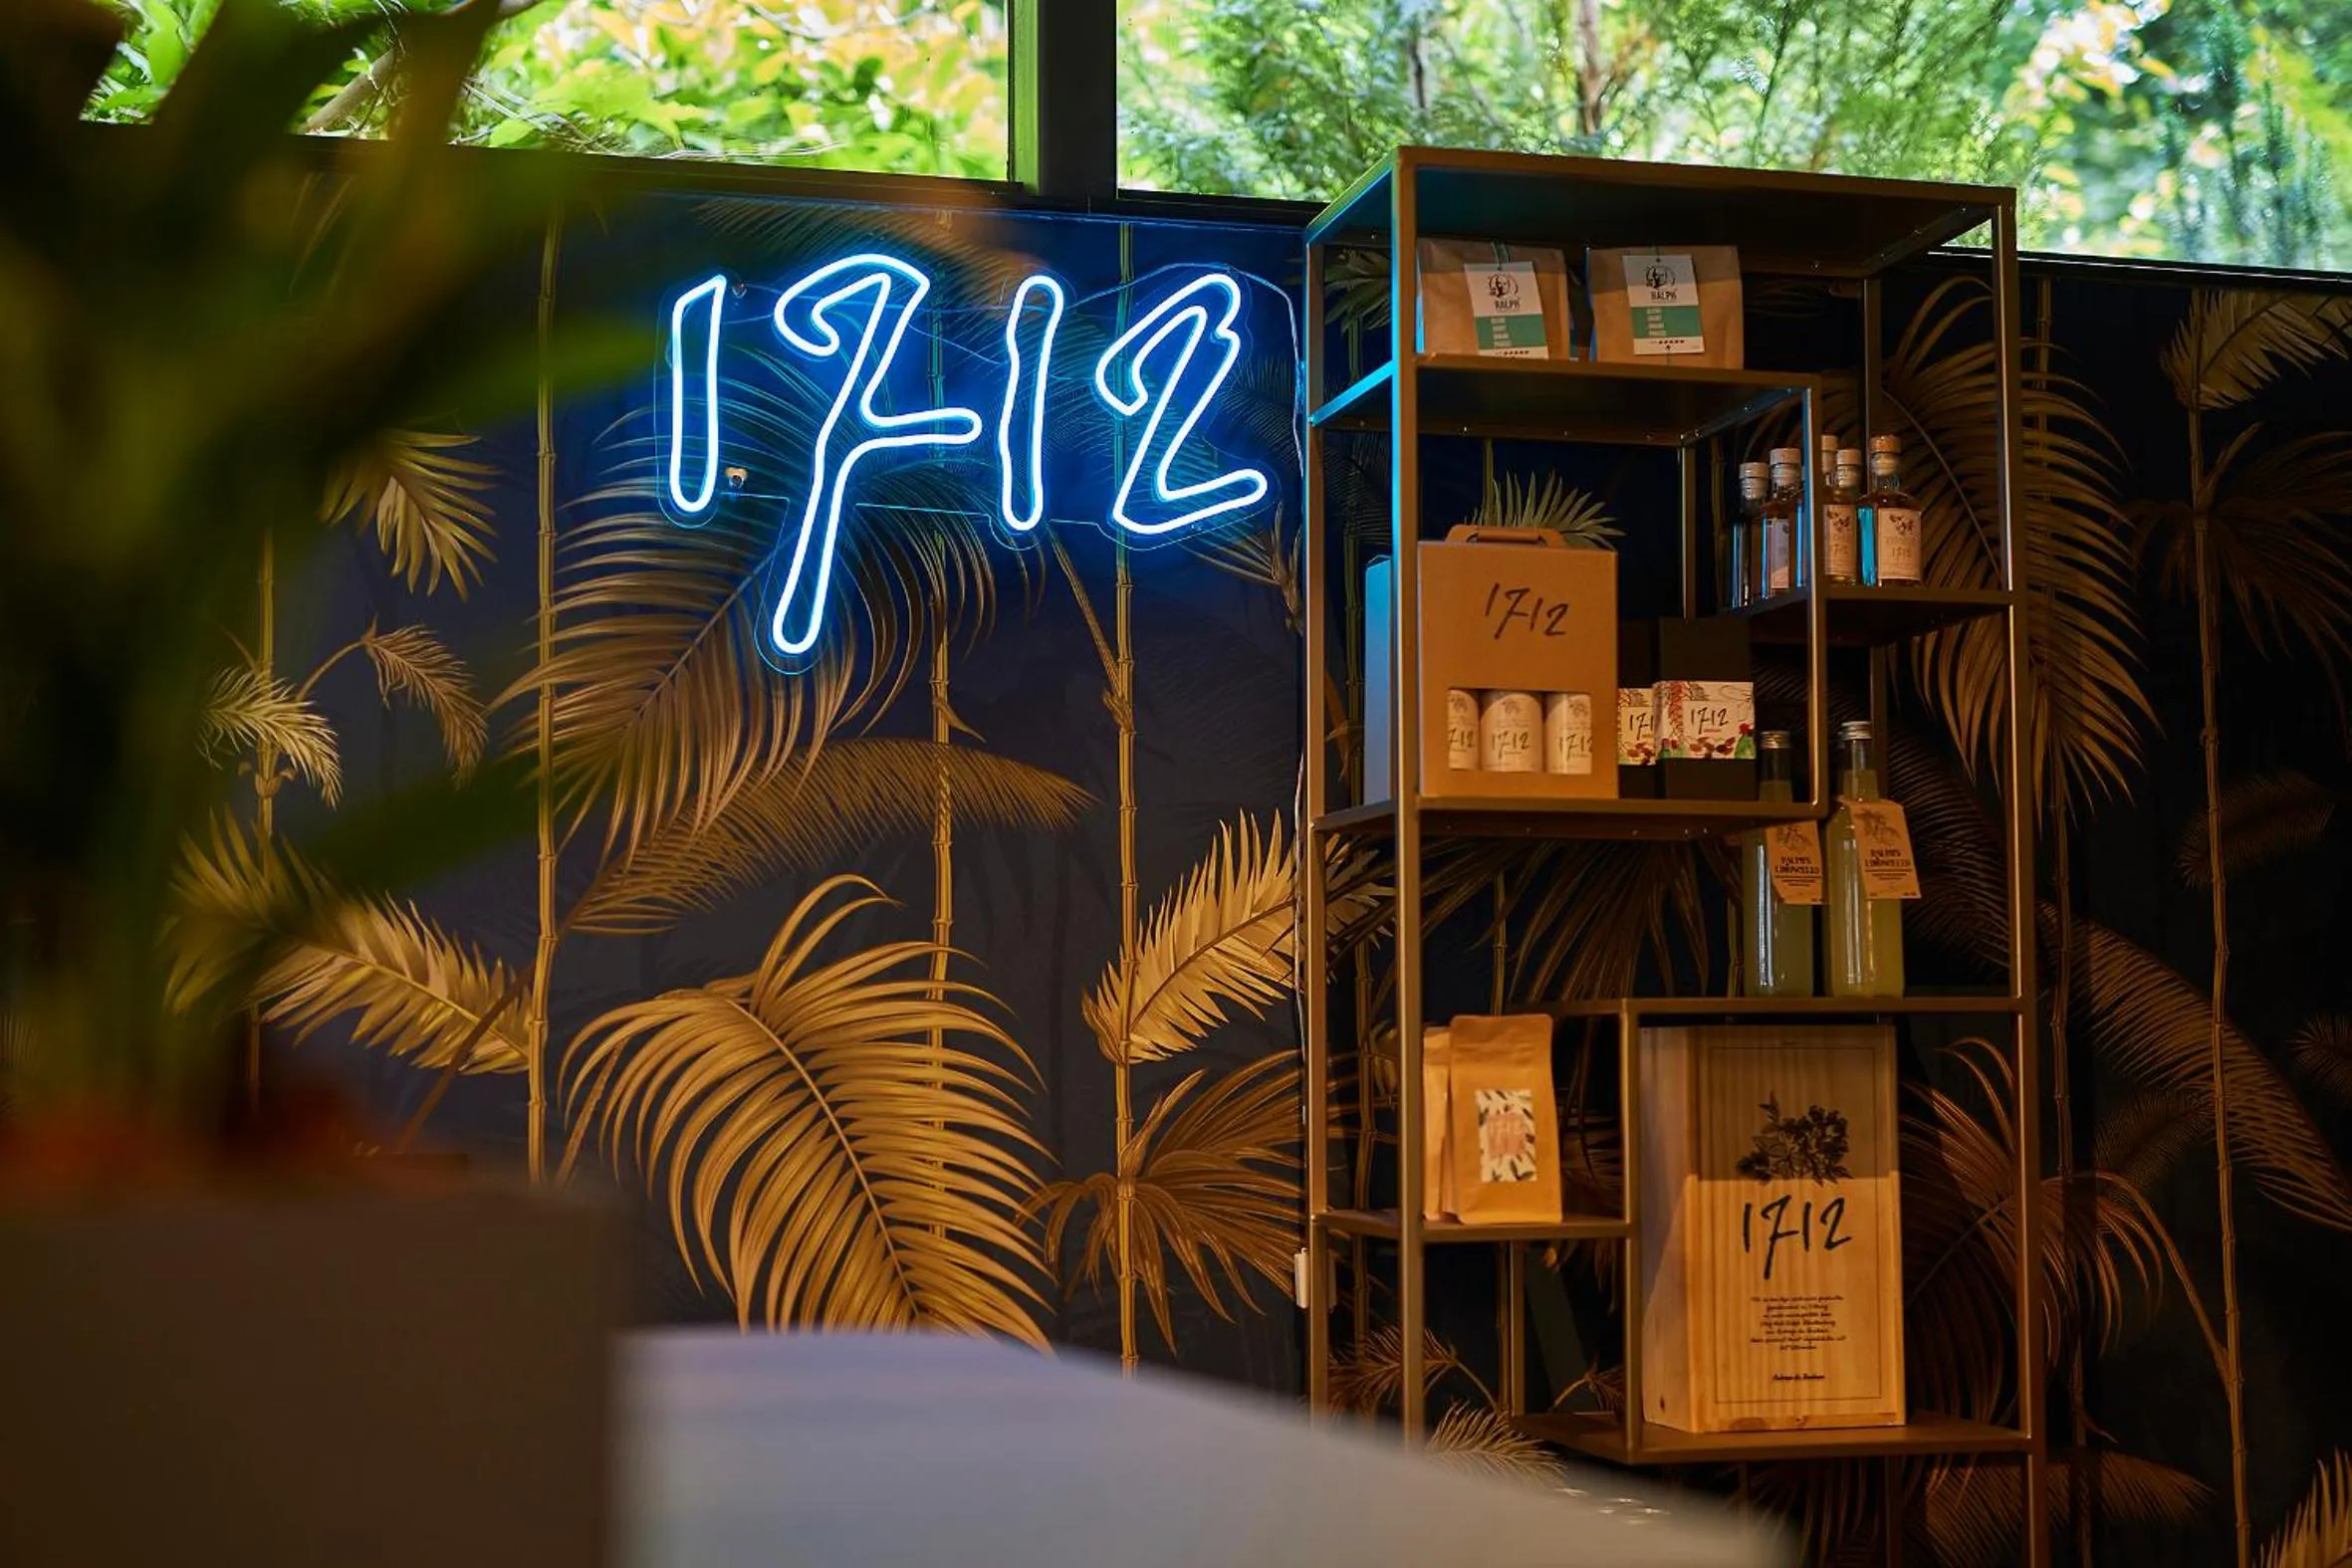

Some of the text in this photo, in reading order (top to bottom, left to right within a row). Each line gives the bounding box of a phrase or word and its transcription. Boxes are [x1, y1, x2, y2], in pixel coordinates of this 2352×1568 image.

[669, 253, 1268, 654] 1712
[1485, 583, 1568, 639] 1712
[1629, 713, 1654, 741] 171
[1691, 706, 1729, 735] 1712
[1448, 727, 1477, 750] 712
[1492, 730, 1530, 760] 1712
[1743, 1195, 1852, 1280] 1712
